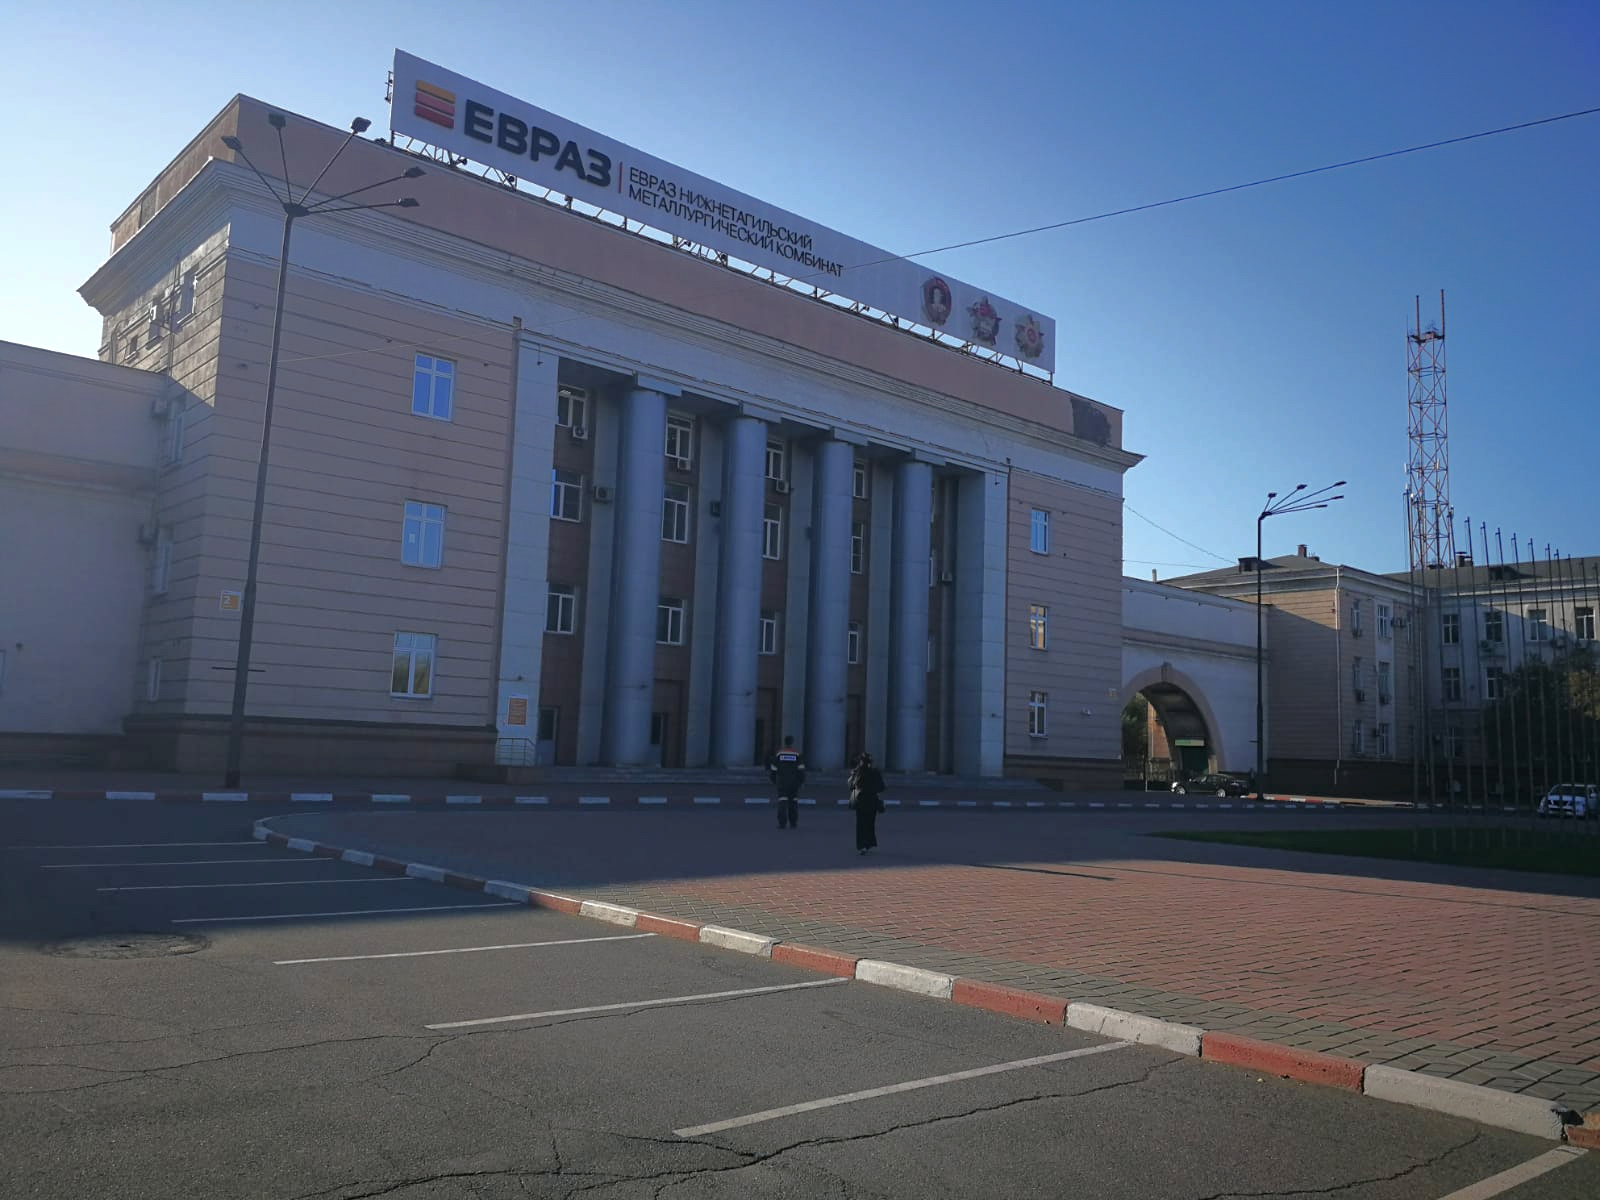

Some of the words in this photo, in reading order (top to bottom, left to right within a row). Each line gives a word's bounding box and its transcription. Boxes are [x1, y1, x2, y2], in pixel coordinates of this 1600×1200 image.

[464, 99, 611, 188] ЕВРАЗ
[629, 184, 774, 251] МЕТАЛЛУРГИЧЕСКИЙ
[776, 241, 843, 277] КОМБИНАТ
[630, 167, 676, 198] ЕВРАЗ
[680, 187, 812, 251] НИЖНЕТАГИЛЬСКИЙ
